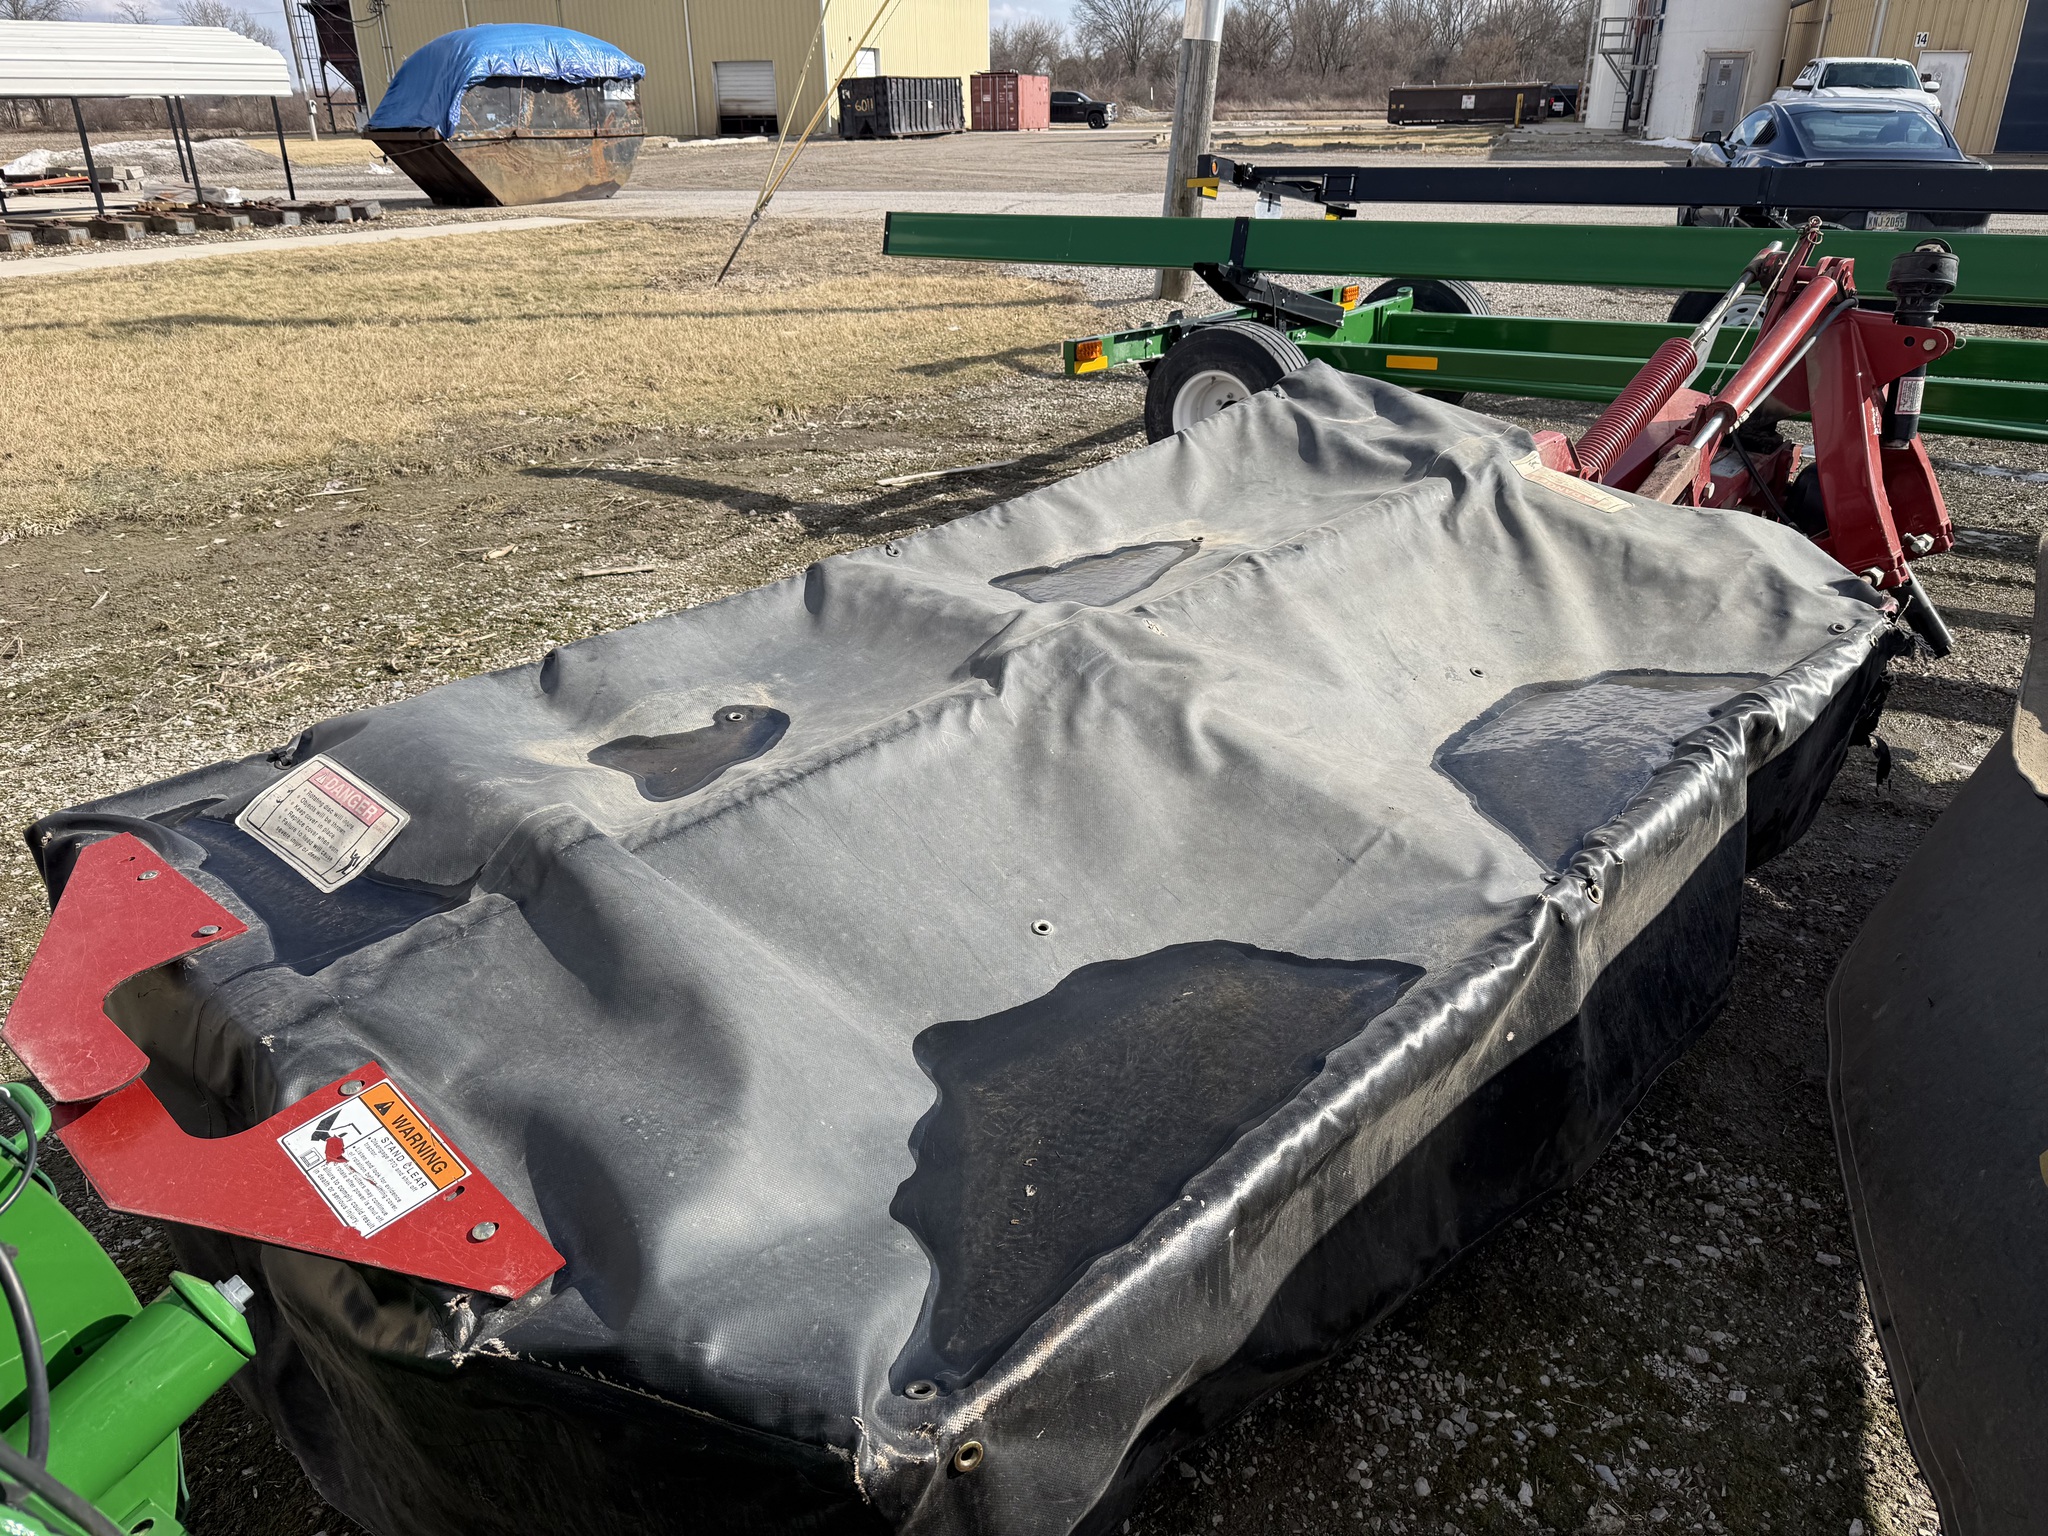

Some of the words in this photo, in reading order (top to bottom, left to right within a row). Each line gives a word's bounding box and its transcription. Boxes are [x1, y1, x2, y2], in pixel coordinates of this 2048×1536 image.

[1916, 33, 1928, 45] 14
[293, 804, 306, 816] Keep
[304, 813, 319, 825] cover
[317, 822, 324, 830] in
[299, 797, 317, 813] Objects
[315, 810, 326, 819] will
[323, 815, 332, 824] be
[326, 777, 378, 820] DANGER
[333, 812, 344, 821] will
[275, 825, 291, 839] severe
[281, 817, 297, 833] Failure
[312, 843, 323, 851] will
[287, 810, 306, 828] Replace
[304, 825, 319, 837] cover
[317, 835, 330, 846] when
[363, 1142, 378, 1157] tractor.
[370, 1138, 390, 1160] Disengage
[387, 1158, 398, 1169] PTO
[394, 1167, 404, 1177] and
[401, 1175, 413, 1186] shut
[380, 1136, 405, 1162] STAND
[402, 1162, 428, 1189] CLEAR
[392, 1114, 447, 1174] WARNING
[352, 1156, 367, 1173] rotation
[354, 1147, 368, 1161] Listen
[364, 1160, 375, 1169] and
[372, 1168, 381, 1178] look
[379, 1177, 387, 1185] for
[384, 1184, 402, 1203] evidence
[318, 1173, 331, 1187] death
[333, 1192, 349, 1209] serious
[345, 1207, 360, 1225] injury.
[320, 1163, 336, 1180] Failure
[337, 1184, 354, 1203] comply
[350, 1201, 366, 1215] could
[361, 1214, 376, 1229] result
[335, 1165, 348, 1179] rotate
[345, 1178, 356, 1189] after
[352, 1188, 367, 1202] power
[367, 1205, 379, 1216] shut
[352, 1174, 367, 1189] cutters
[364, 1188, 374, 1199] may
[371, 1197, 389, 1217] continue
